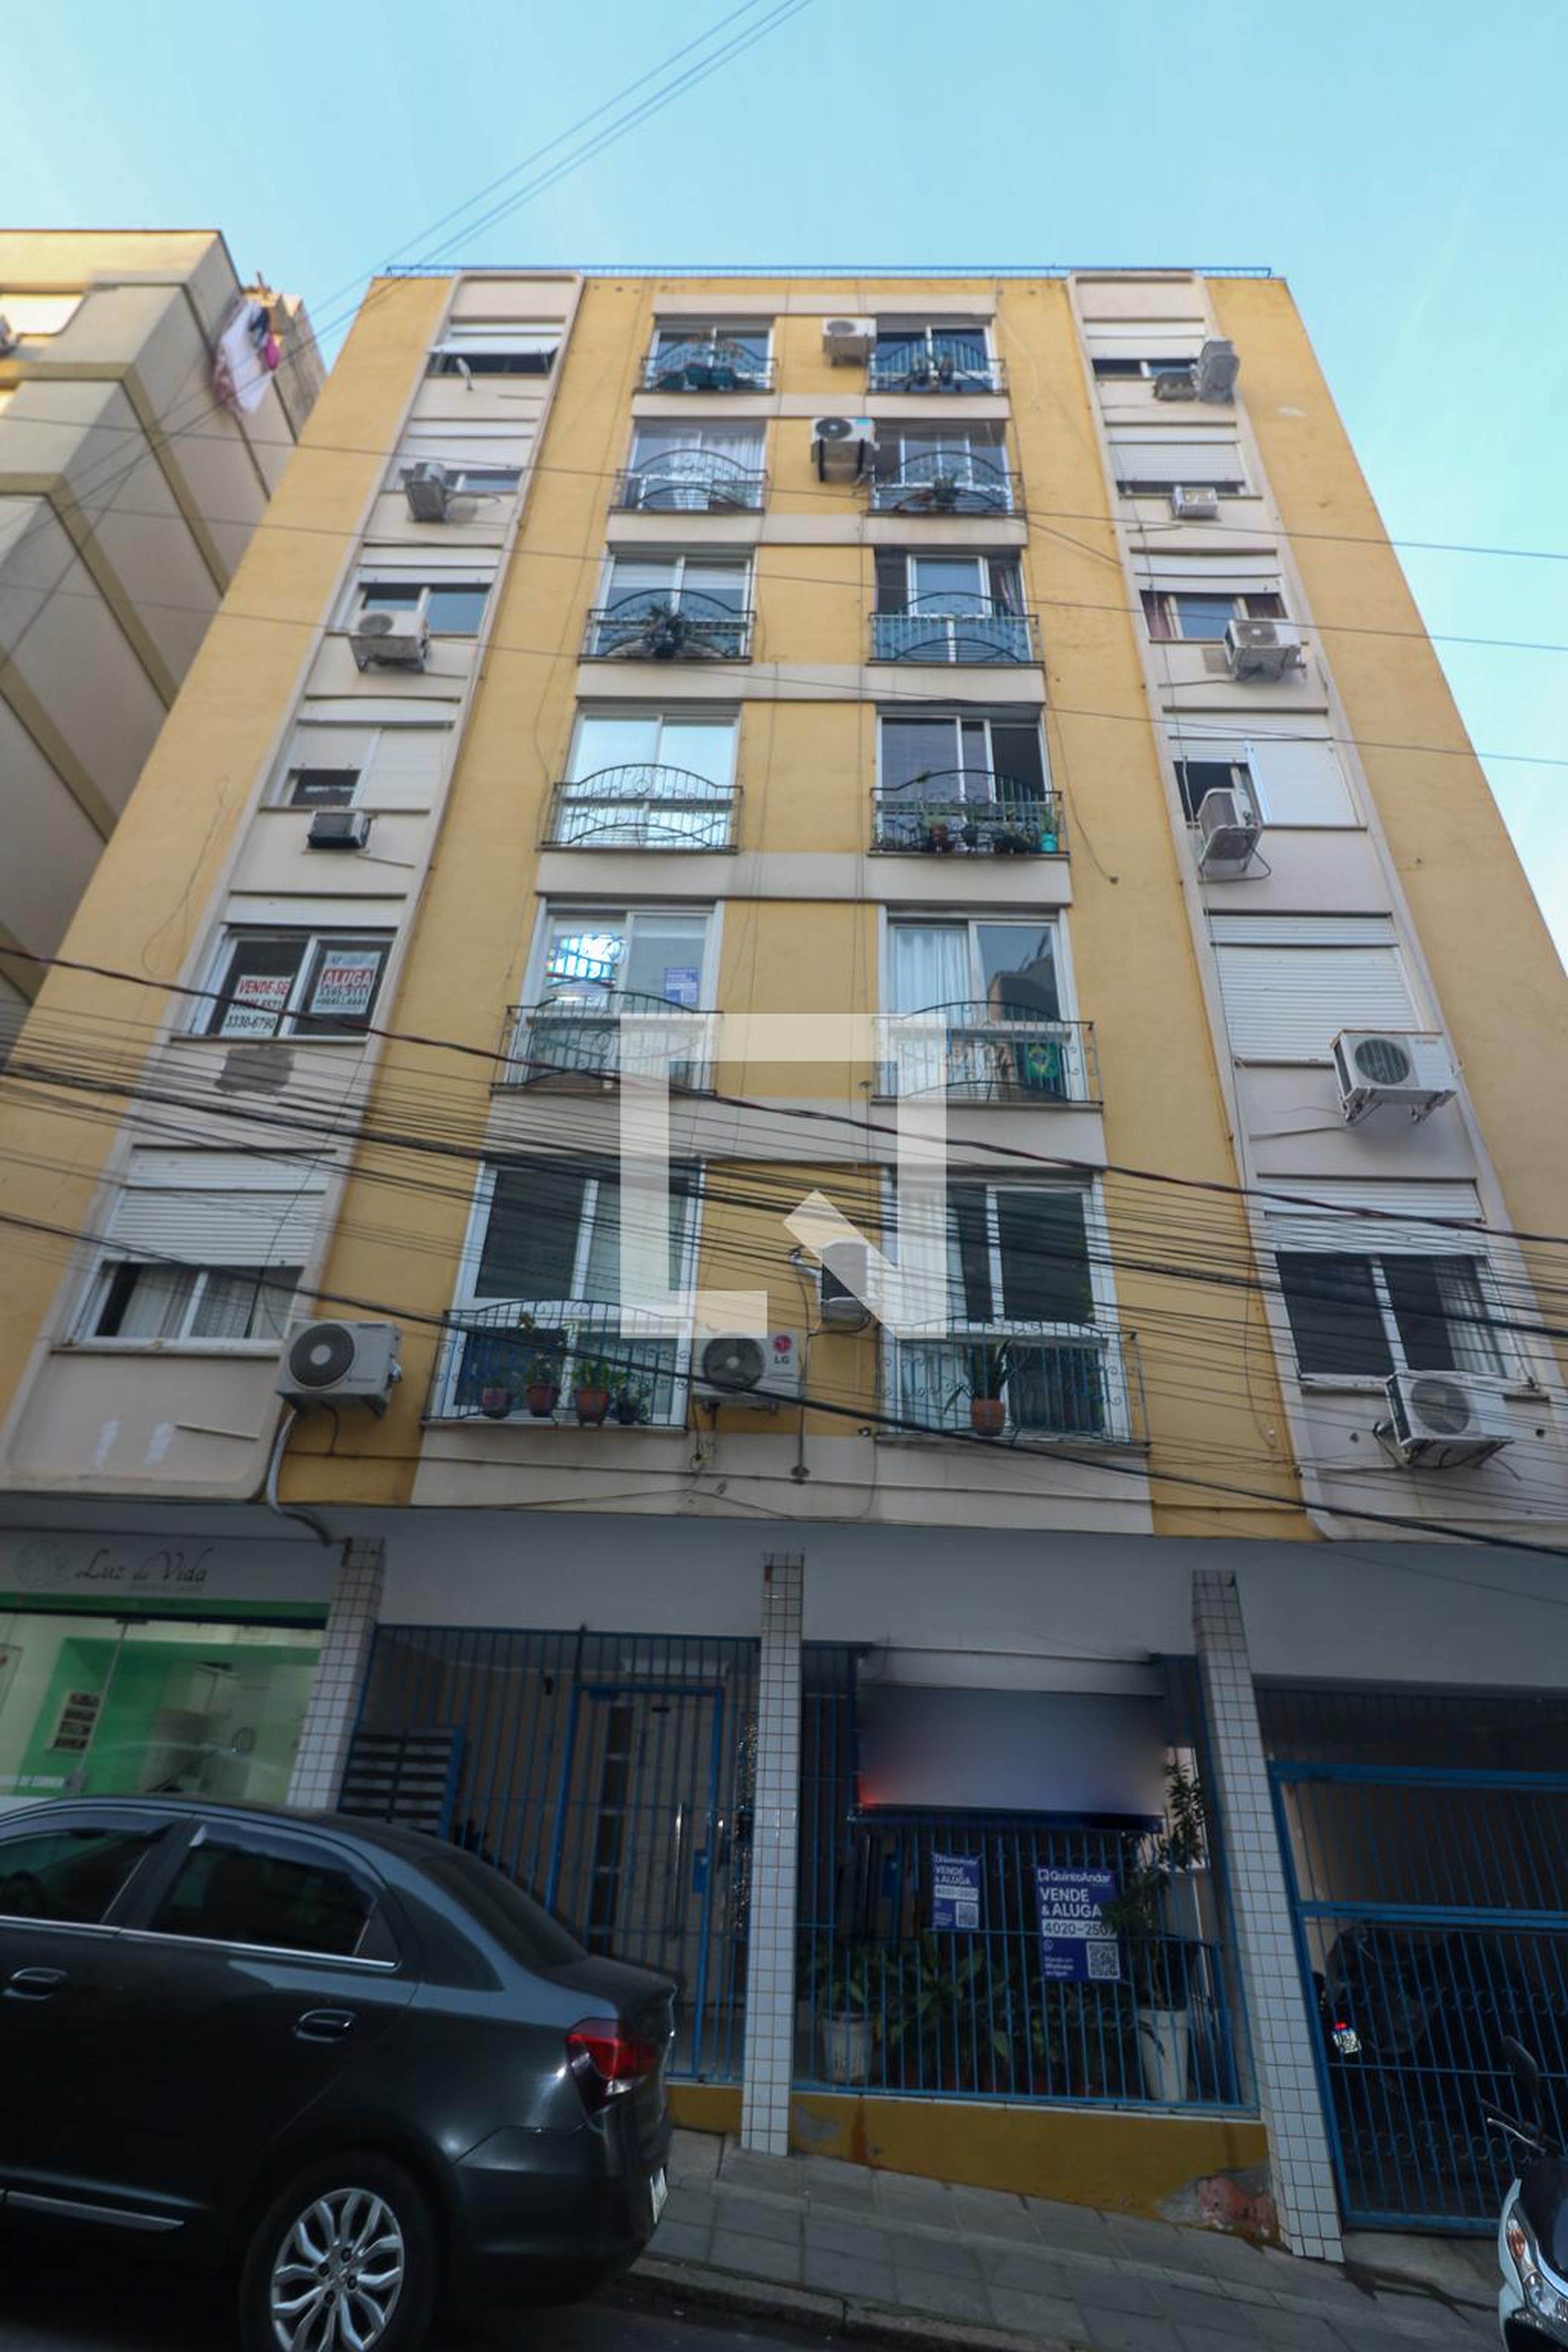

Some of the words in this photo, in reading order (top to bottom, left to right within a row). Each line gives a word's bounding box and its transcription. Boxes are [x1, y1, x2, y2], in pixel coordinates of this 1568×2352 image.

[323, 971, 372, 987] ALUGA
[775, 1355, 790, 1364] LG
[1050, 1870, 1110, 1883] QuintoAndar
[1041, 1887, 1090, 1902] VENDE
[1042, 1904, 1049, 1916] &
[1053, 1903, 1102, 1918] ALUGA
